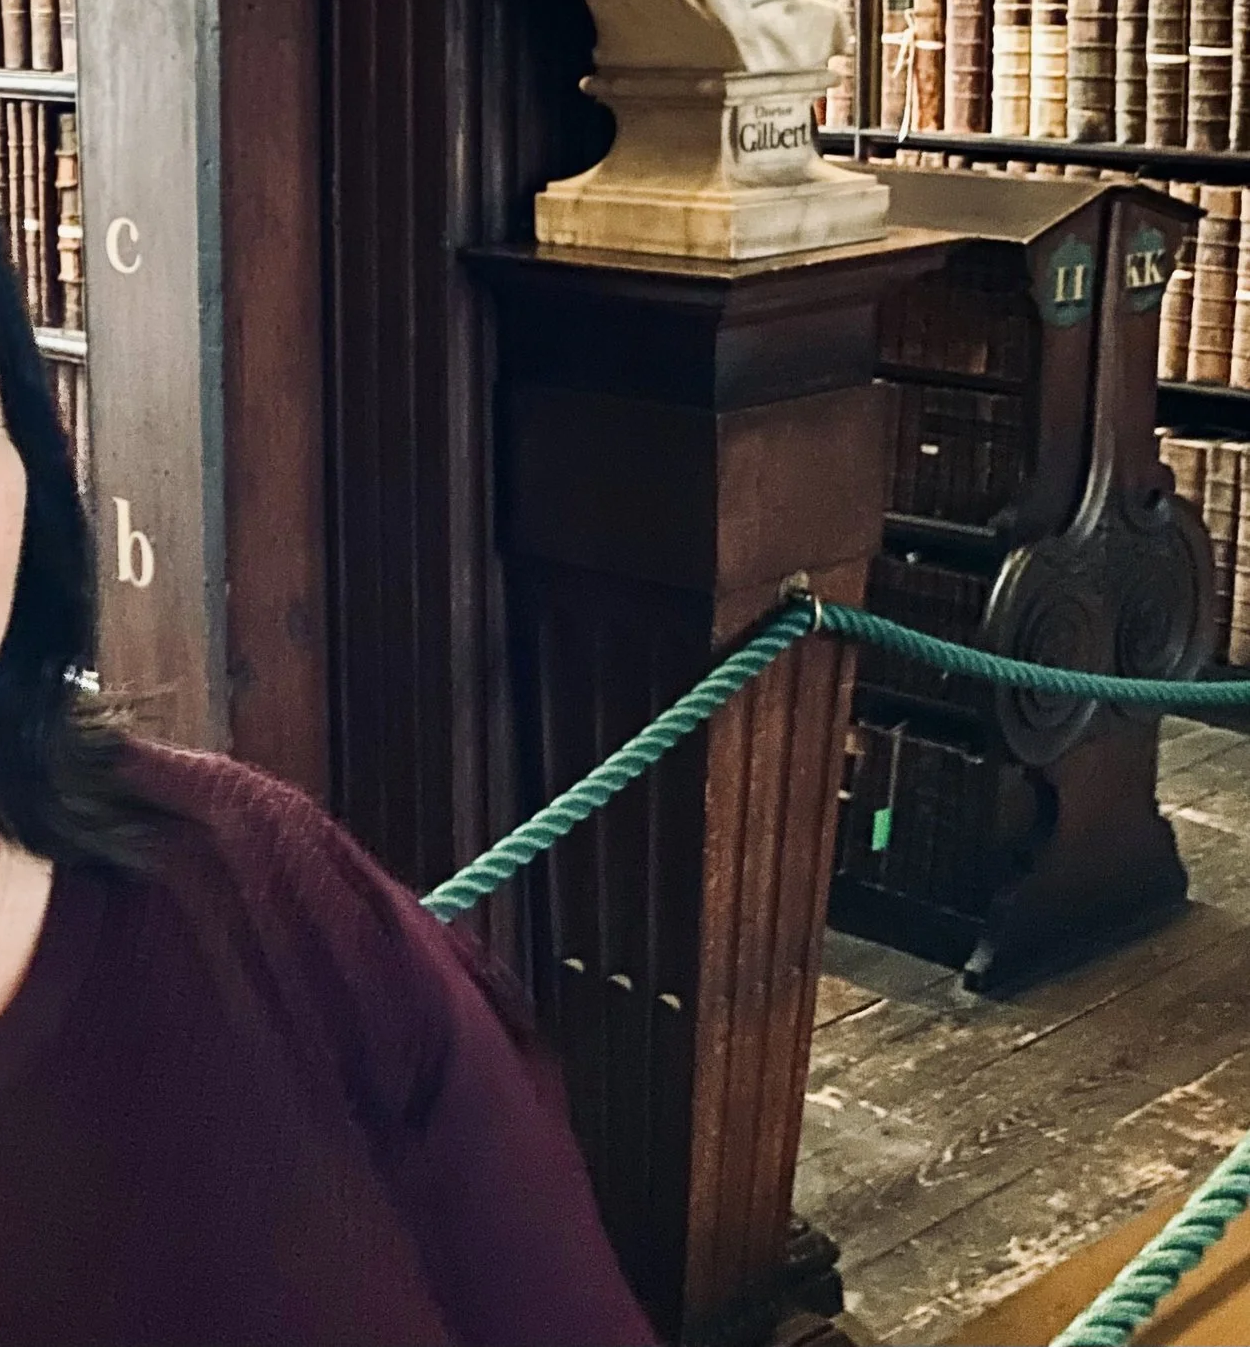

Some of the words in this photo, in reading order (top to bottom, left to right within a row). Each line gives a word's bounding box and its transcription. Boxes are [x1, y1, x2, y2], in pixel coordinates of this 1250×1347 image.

[739, 120, 810, 154] Gilbert
[105, 217, 142, 274] c
[112, 496, 155, 588] b
